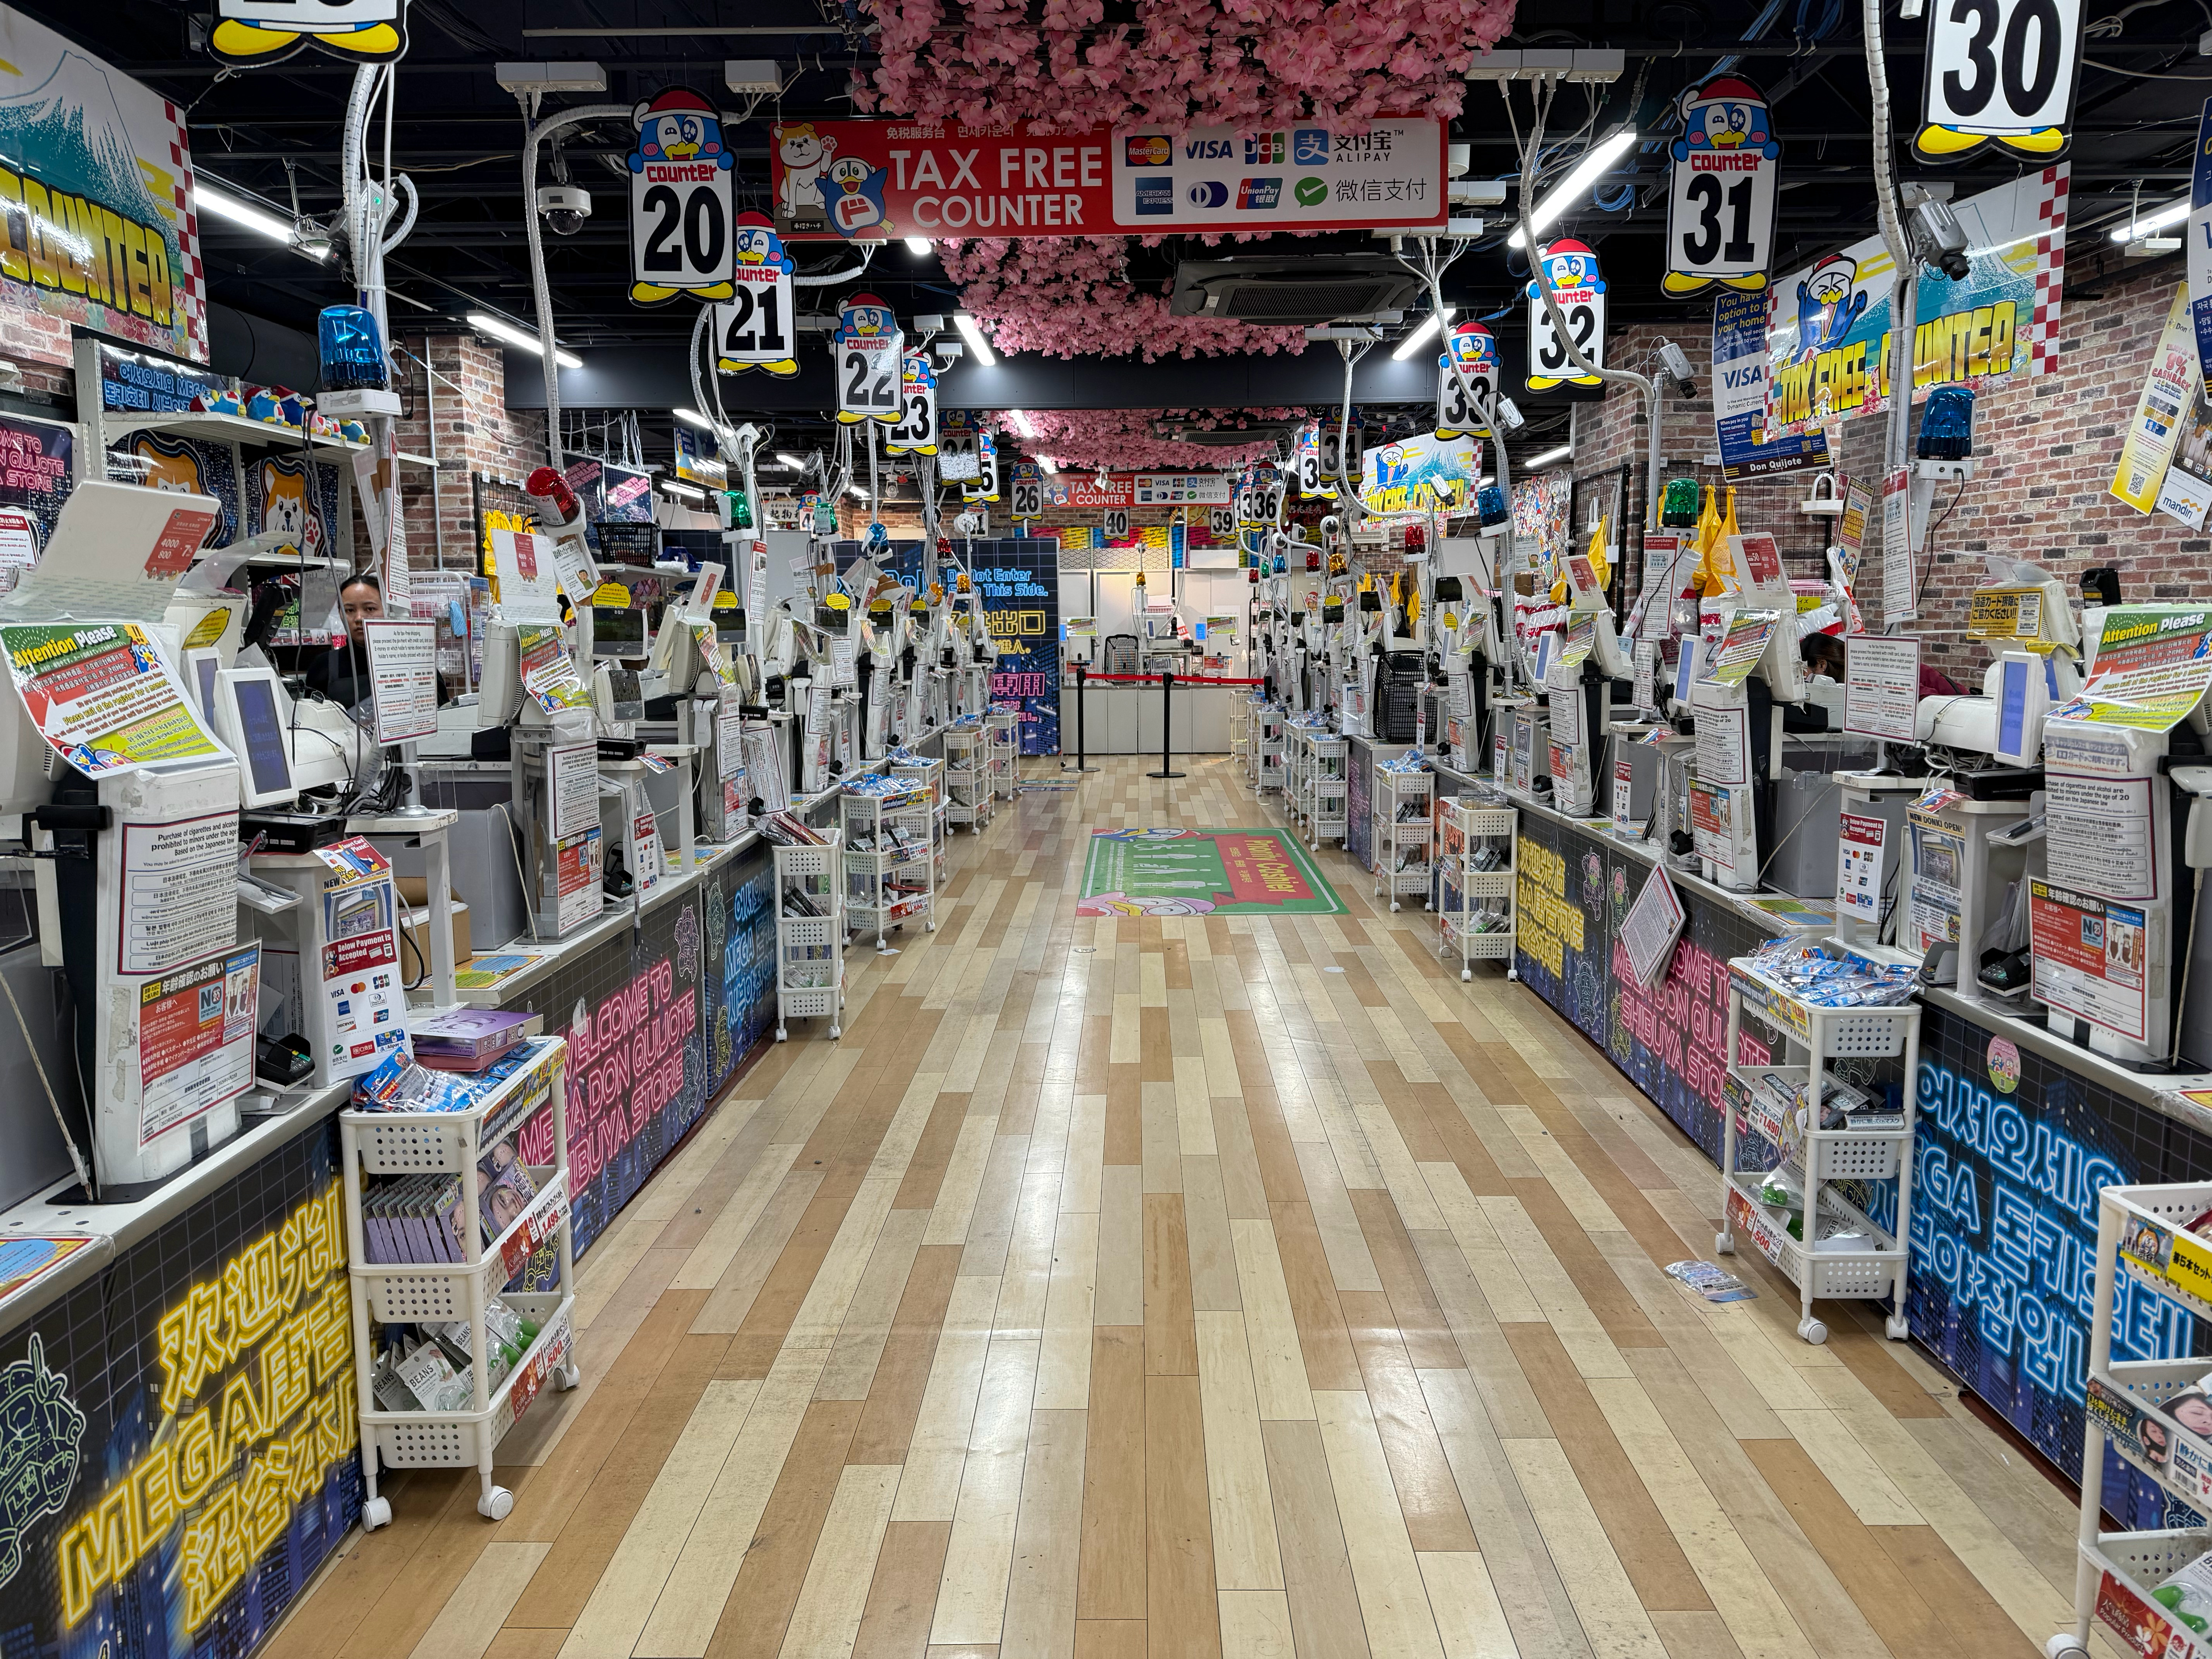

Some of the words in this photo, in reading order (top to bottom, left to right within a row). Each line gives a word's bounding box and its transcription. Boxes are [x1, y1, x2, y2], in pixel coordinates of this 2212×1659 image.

[1943, 0, 2061, 118] 30
[886, 126, 945, 140] 免税服务台
[958, 125, 1014, 138] 면세카운터
[1334, 131, 1392, 151] 支付宝
[1128, 145, 1169, 156] MasterCard
[1186, 141, 1233, 159] VISA
[1245, 142, 1285, 156] JCB
[1336, 153, 1391, 163] ALIPAY
[890, 149, 982, 190] TAX
[1000, 146, 1103, 188] FREE
[1691, 153, 1762, 172] counter
[646, 164, 717, 183] counter
[1240, 186, 1280, 198] UnionPay
[1336, 179, 1427, 202] 微信支付
[913, 194, 1084, 228] COUNTER
[1683, 173, 1755, 265] 31
[642, 184, 725, 275] 20
[1721, 296, 1737, 308] You
[726, 286, 785, 352] 21
[1719, 307, 1747, 322] option
[1750, 304, 1760, 314] to
[1717, 320, 1738, 337] your
[1740, 315, 1765, 328] home
[2176, 323, 2187, 333] Don
[847, 338, 892, 350] counter
[1539, 304, 1595, 370] 32
[2166, 353, 2188, 376] 8%
[845, 352, 895, 406] 22
[1721, 365, 1762, 390] VISA
[1781, 357, 1816, 426] TAX
[1815, 340, 1866, 413] FREE
[2152, 368, 2191, 393] CASHBACK
[1445, 376, 1491, 425] 33
[943, 429, 972, 438] counter
[26, 436, 42, 452] TO
[1324, 434, 1357, 477] 34
[1750, 462, 1767, 472] Don
[1769, 456, 1802, 469] Quijote
[7, 470, 53, 492] STORE
[1070, 481, 1095, 494] TAX
[1015, 485, 1037, 513] 26
[1076, 495, 1126, 505] COUNTER
[1254, 489, 1277, 519] 36
[2164, 495, 2194, 520] mandiri
[1106, 512, 1127, 534] 40
[1212, 511, 1233, 532] 39
[161, 539, 180, 548] 4000
[158, 551, 172, 559] 800
[994, 568, 1032, 582] Enter
[986, 584, 1013, 597] This
[1015, 583, 1048, 597] Side.
[540, 627, 554, 639] Please
[2102, 622, 2159, 644] Attention
[2160, 613, 2205, 632] Please
[13, 637, 77, 668] Attention
[74, 625, 118, 647] Please
[63, 714, 84, 725] Please
[83, 708, 96, 718] wait
[103, 701, 113, 710] the
[113, 693, 136, 706] register
[2066, 782, 2087, 790] cigarettes
[2080, 797, 2100, 805] Japanese
[158, 833, 182, 842] Purchase
[189, 826, 211, 836] cigarettes
[222, 820, 237, 829] alcohol
[1860, 820, 1878, 829] Payment
[1910, 812, 1922, 822] NEW
[1924, 815, 1942, 828] DONKI
[1944, 821, 1963, 833] OPEN!
[151, 840, 182, 852] prohibited
[189, 835, 205, 844] minors
[175, 847, 188, 856] Based
[205, 840, 226, 850] Japanese
[342, 841, 354, 850] Insert
[1244, 840, 1283, 861] Priority
[333, 865, 346, 874] NO
[1256, 862, 1299, 892] Cashier
[324, 876, 341, 890] NEW
[2044, 903, 2063, 914] お客様へ
[2048, 888, 2104, 913] 年齢確認のお願い
[338, 942, 356, 953] Below
[356, 935, 384, 948] Payment
[338, 948, 368, 962] Accepted
[162, 962, 224, 994] 年齢確認のお願い
[373, 978, 389, 986] JCB
[651, 959, 673, 1010] TO
[331, 989, 345, 998] VISA
[156, 1000, 178, 1014] お客様へ
[337, 1020, 355, 1029] DISCOVER
[1621, 989, 1684, 1080] SHIBUYA
[168, 1045, 196, 1062] マイナンバーカード
[588, 1044, 630, 1119] DON
[632, 988, 696, 1079] QUIJOTE
[631, 1047, 684, 1137] STORE
[455, 1326, 472, 1346] BEANS
[374, 1372, 395, 1393] BEANS
[409, 1364, 434, 1389] BEANS
[2099, 1607, 2121, 1630] Popular
